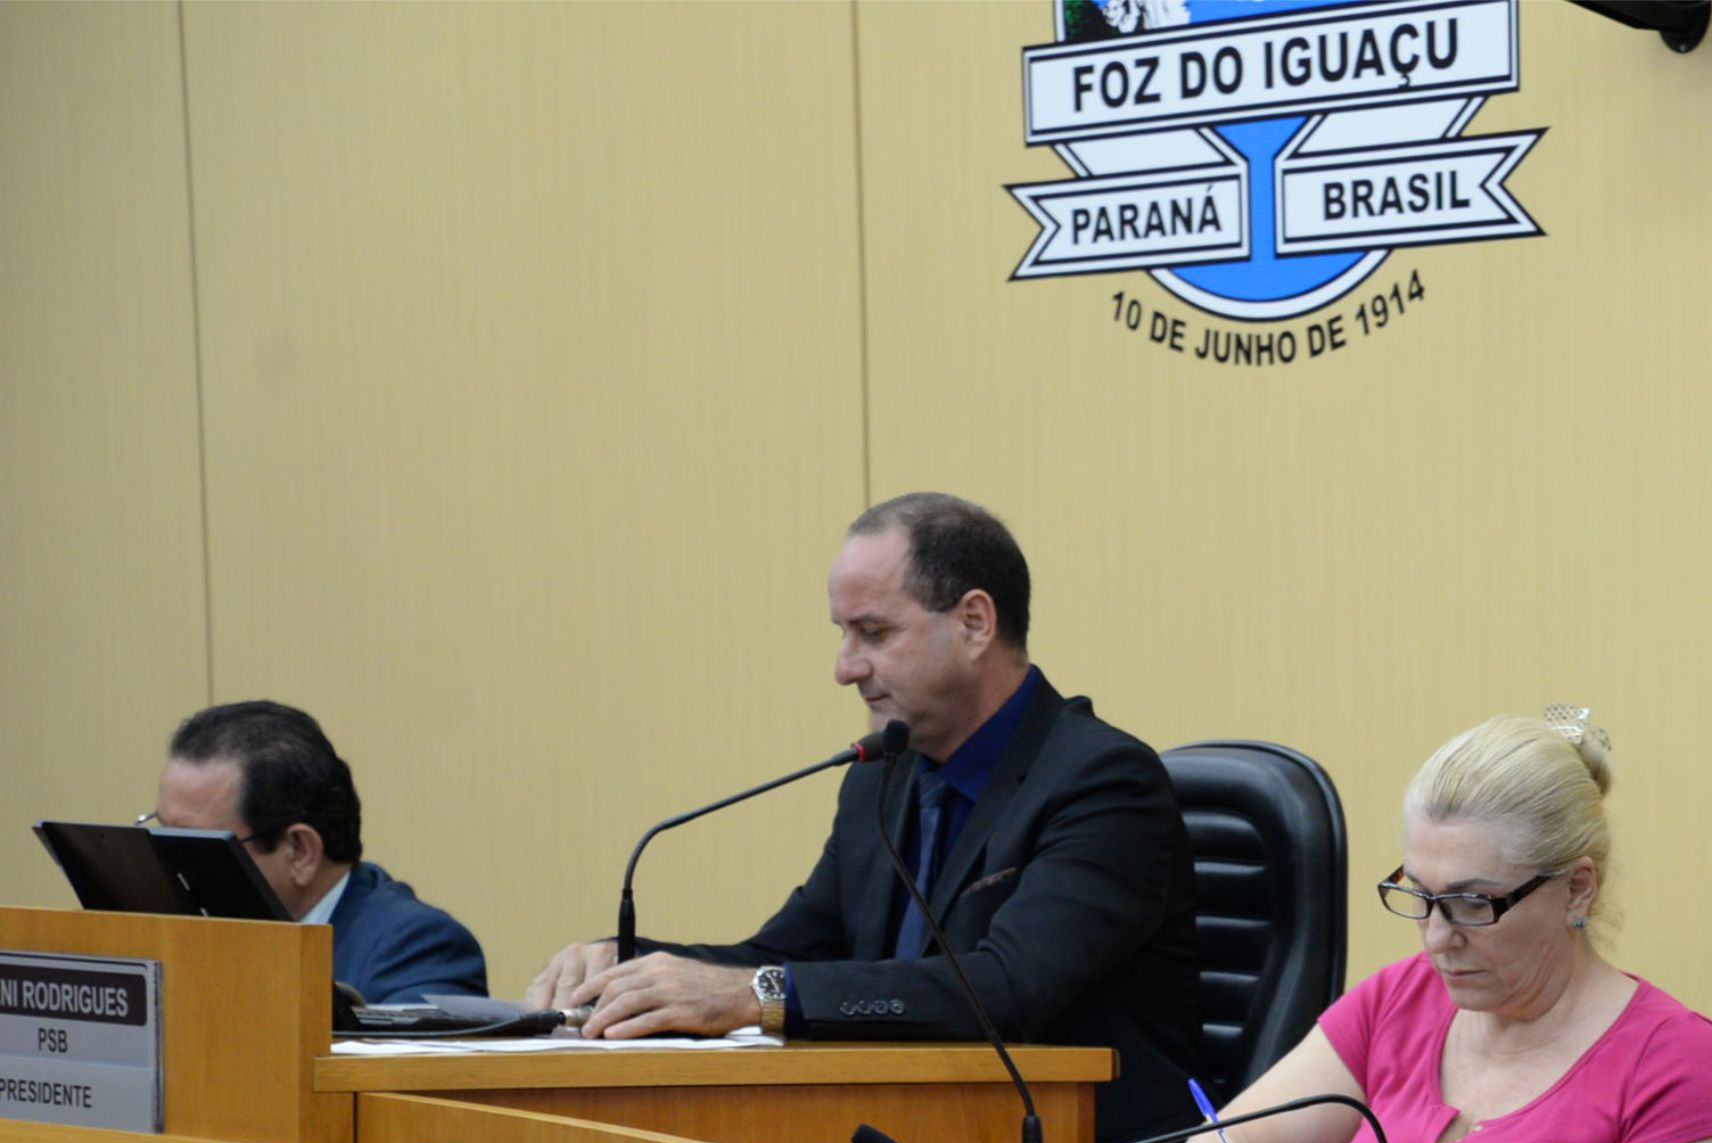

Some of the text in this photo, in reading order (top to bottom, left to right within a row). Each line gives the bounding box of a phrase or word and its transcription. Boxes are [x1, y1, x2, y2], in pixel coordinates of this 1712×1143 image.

[1073, 18, 1459, 112] FOZ DO IGUAÇU
[1071, 186, 1222, 245] PARANÁ
[1323, 170, 1470, 220] BRASIL
[1112, 269, 1425, 366] 10 DE JUNHO DE 1914
[22, 980, 128, 1017] RODRIGUES
[38, 1028, 68, 1052] PSB
